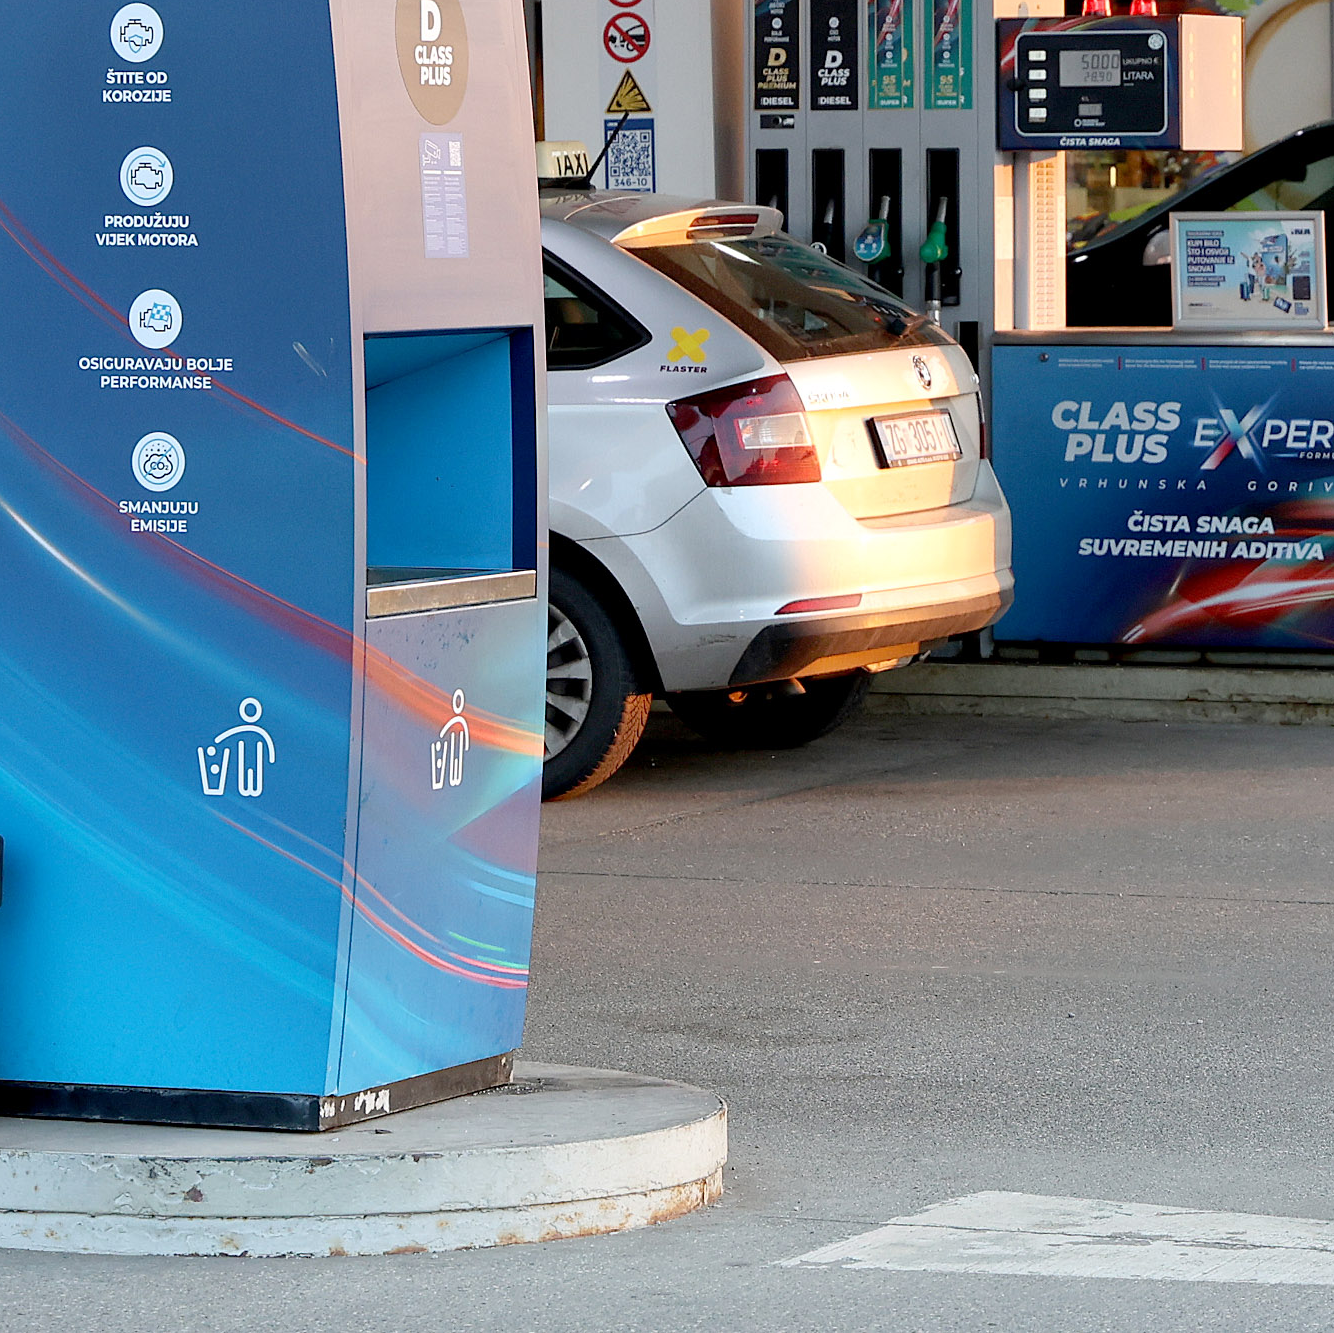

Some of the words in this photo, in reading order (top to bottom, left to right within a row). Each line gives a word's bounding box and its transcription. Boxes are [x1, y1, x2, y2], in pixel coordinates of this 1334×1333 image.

[419, 0, 442, 42] D
[415, 45, 453, 66] CLASS
[767, 48, 787, 66] D
[824, 50, 843, 68] D
[106, 69, 144, 84] ŠTITE
[146, 72, 168, 84] OD
[420, 67, 452, 86] PLUS
[818, 68, 850, 77] CLASS
[1123, 71, 1154, 80] LITARA
[821, 77, 847, 86] PLUS
[102, 90, 171, 102] KOROZIJE
[763, 97, 794, 105] DIESEL
[820, 97, 851, 105] DIESEL
[1060, 137, 1087, 146] ČISTA
[556, 152, 588, 176] TAXI
[613, 177, 647, 188] 346-10
[104, 212, 189, 228] PRODUŽUJU
[96, 234, 136, 246] VIJEK
[138, 234, 198, 247] MOTORA
[78, 357, 183, 371] OSIGURAVAJU
[187, 358, 233, 371] BOLJE
[659, 364, 708, 373] FLASTER
[100, 376, 211, 389] PERFORMANSE
[1052, 400, 1182, 432] CLASS
[885, 424, 907, 455] ZG
[1064, 433, 1169, 464] PLUS
[1060, 478, 1207, 490] VRHUNSKA
[119, 501, 199, 514] SMANJUJU
[130, 519, 188, 533] EMISIJE
[1127, 511, 1191, 534] ČISTA
[1196, 515, 1275, 535] SNAGA
[1079, 538, 1226, 560] SUVREMENIH
[1232, 541, 1325, 561] ADITIVA
